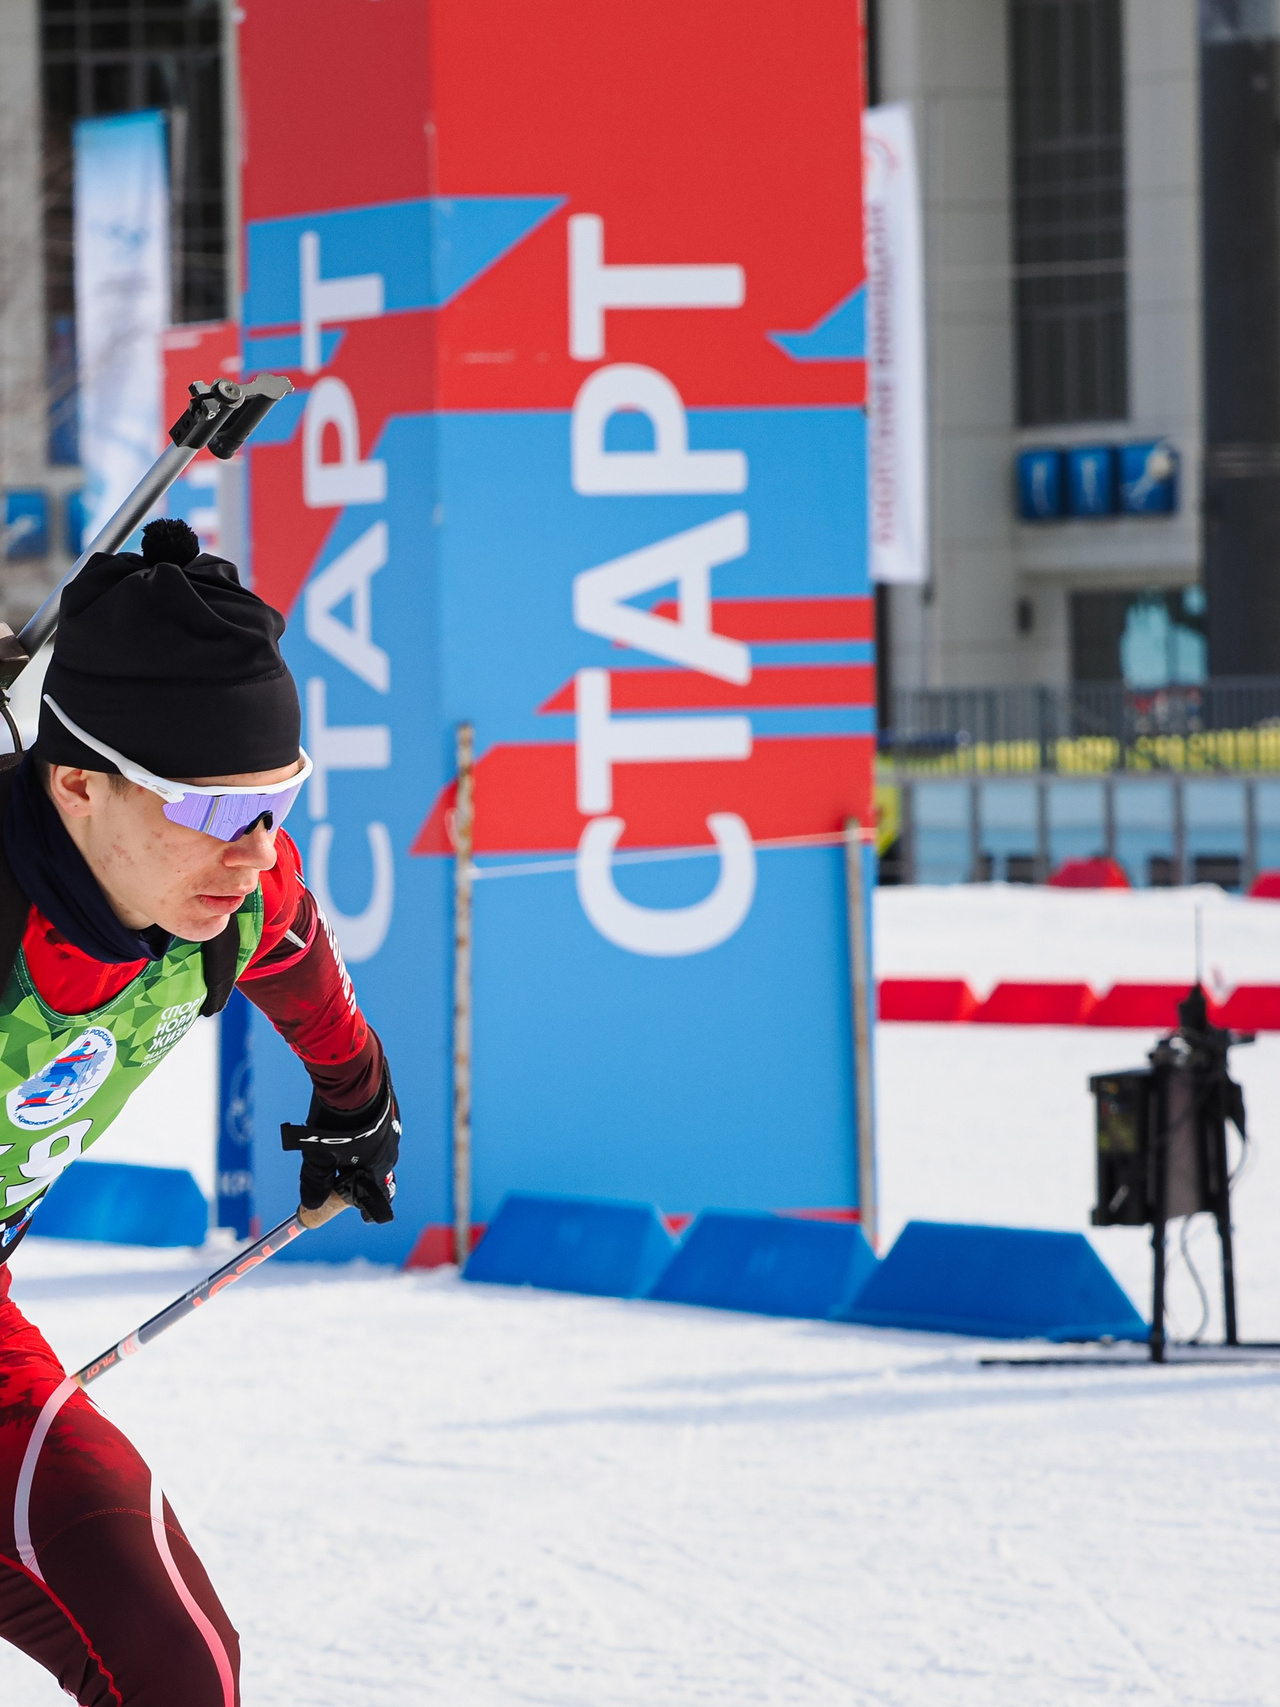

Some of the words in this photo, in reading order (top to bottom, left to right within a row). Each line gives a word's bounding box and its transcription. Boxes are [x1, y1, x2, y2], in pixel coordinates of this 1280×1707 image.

[300, 231, 394, 963] СТАРТ
[569, 214, 756, 957] СТАРТ
[89, 1028, 113, 1049] РОССИИ
[86, 1352, 116, 1381] PILOT
